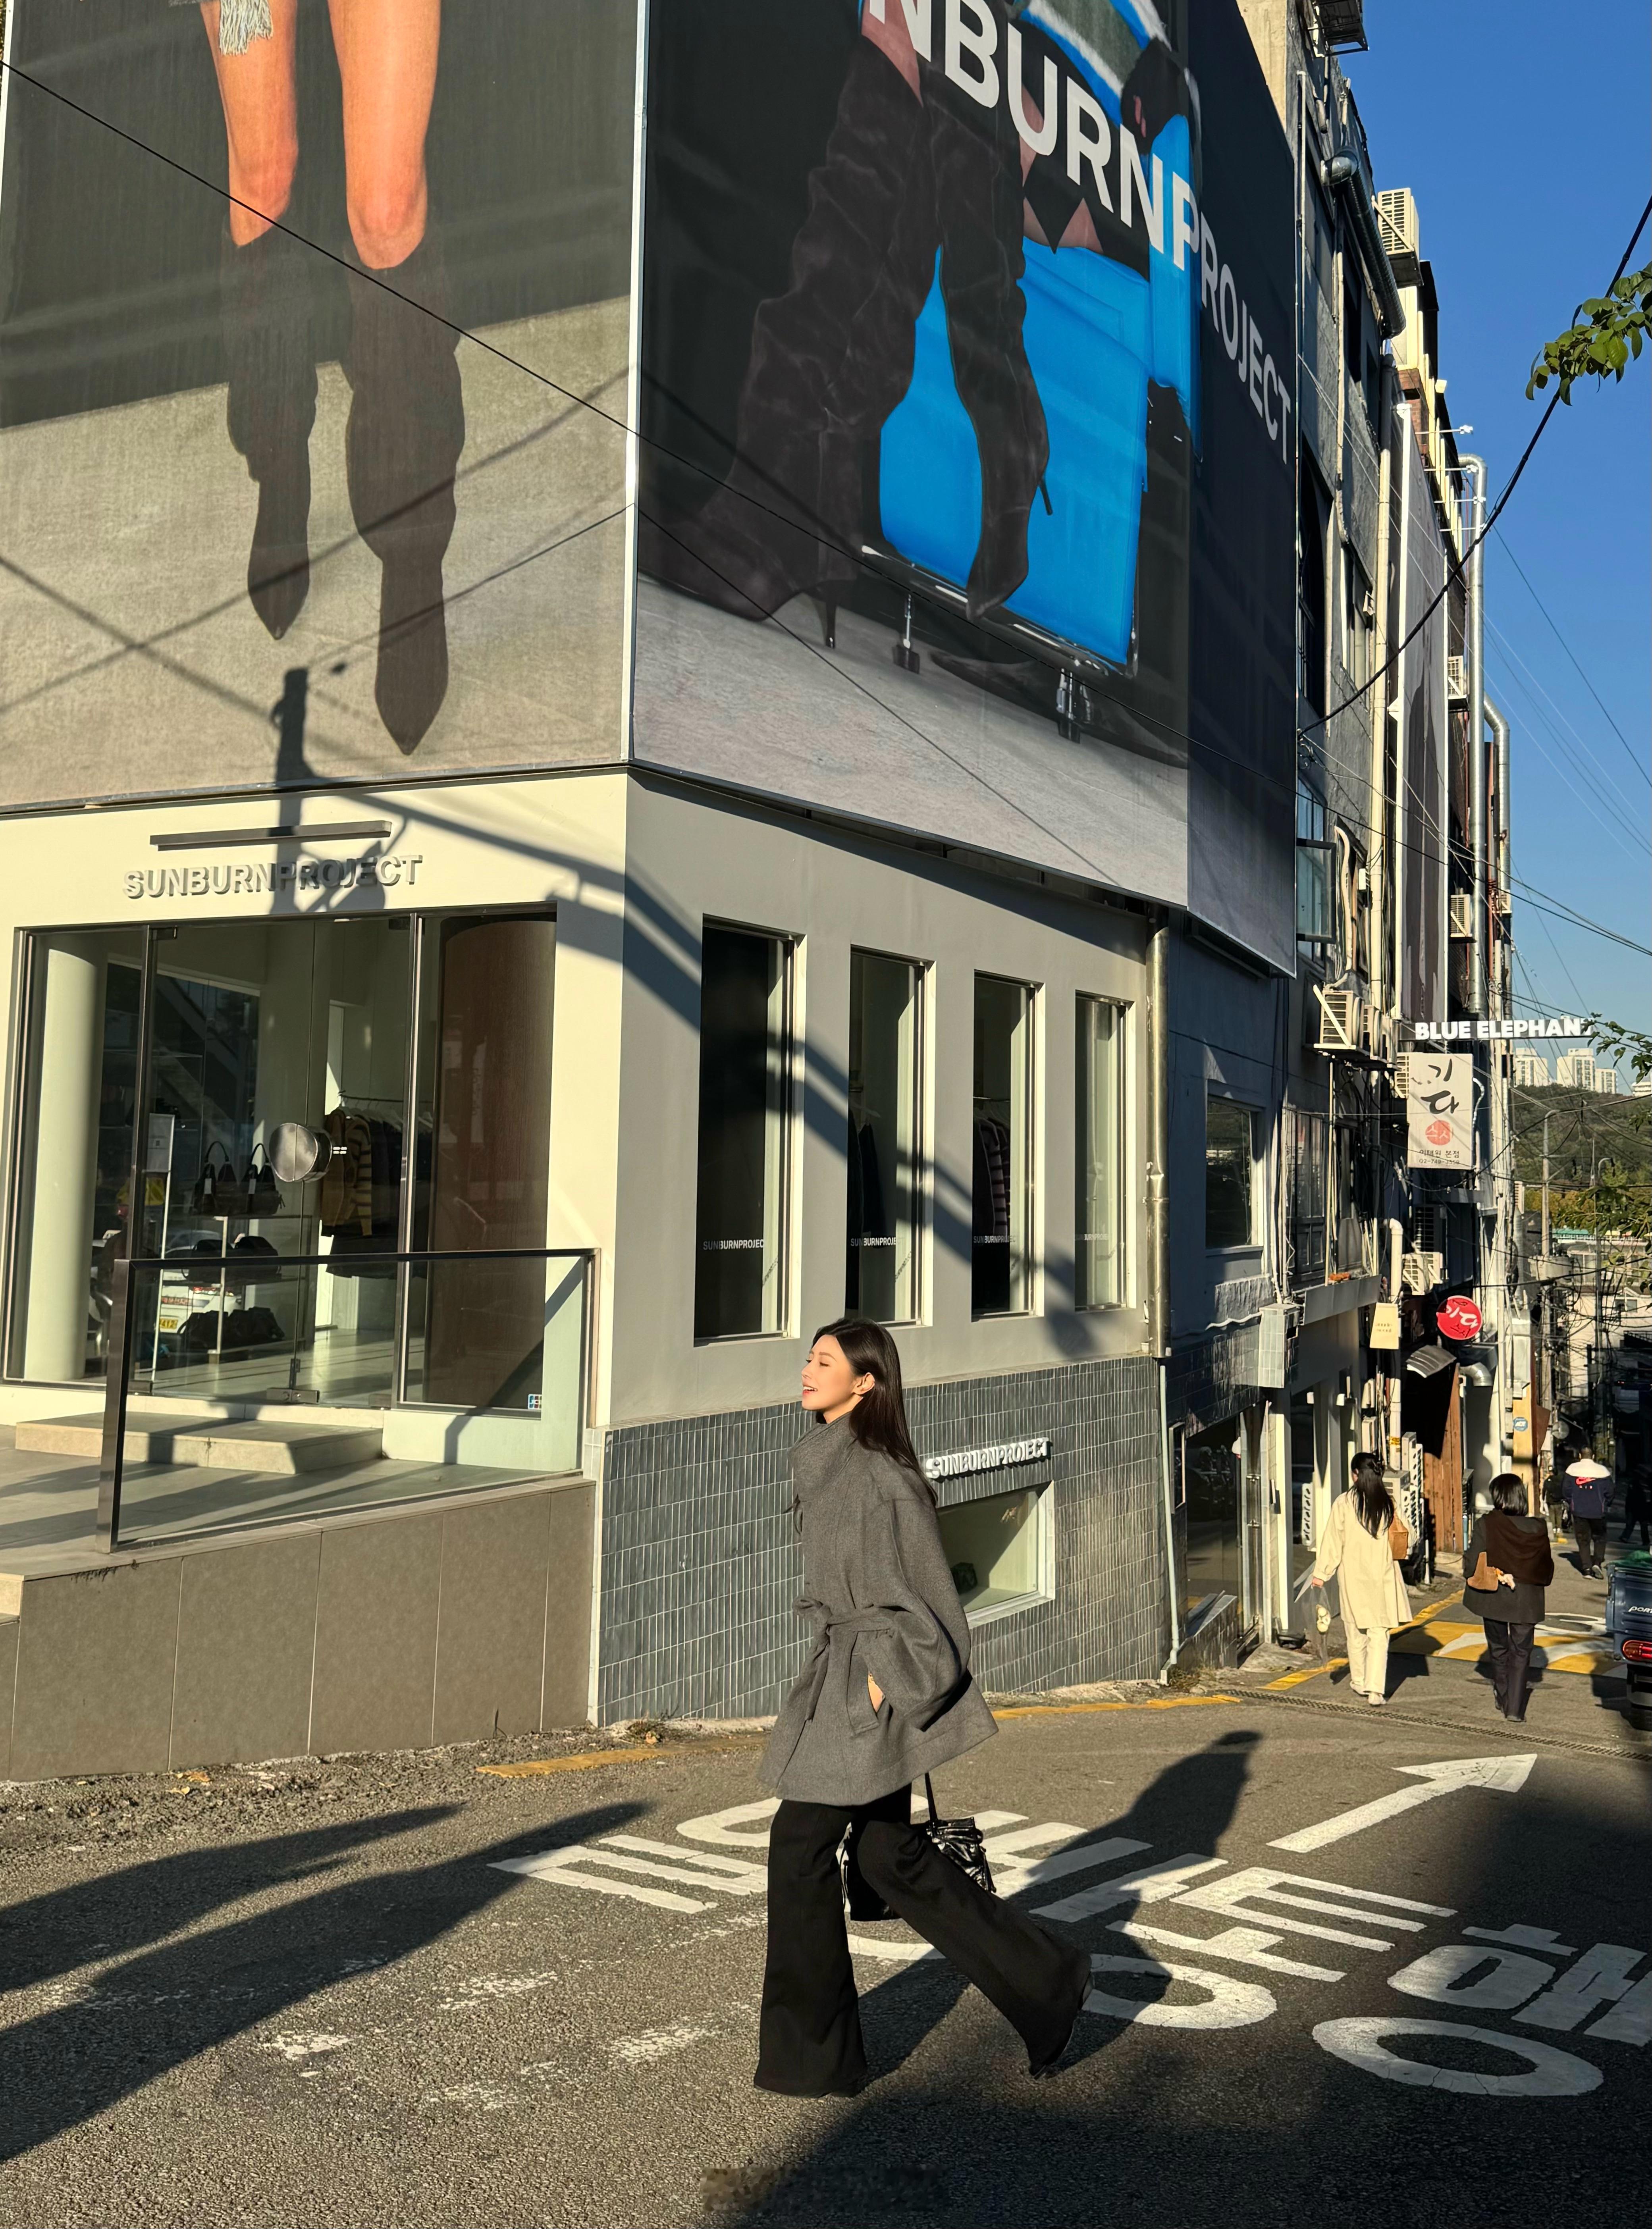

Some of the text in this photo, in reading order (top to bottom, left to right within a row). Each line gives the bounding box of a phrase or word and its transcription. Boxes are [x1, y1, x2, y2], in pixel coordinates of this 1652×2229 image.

[123, 854, 423, 898] SUNBURNPROJECT
[1415, 1021, 1471, 1040] BLUE
[703, 1239, 764, 1250] SUNBURNPROJEC
[926, 1437, 1051, 1479] SUNBURNPROJECT
